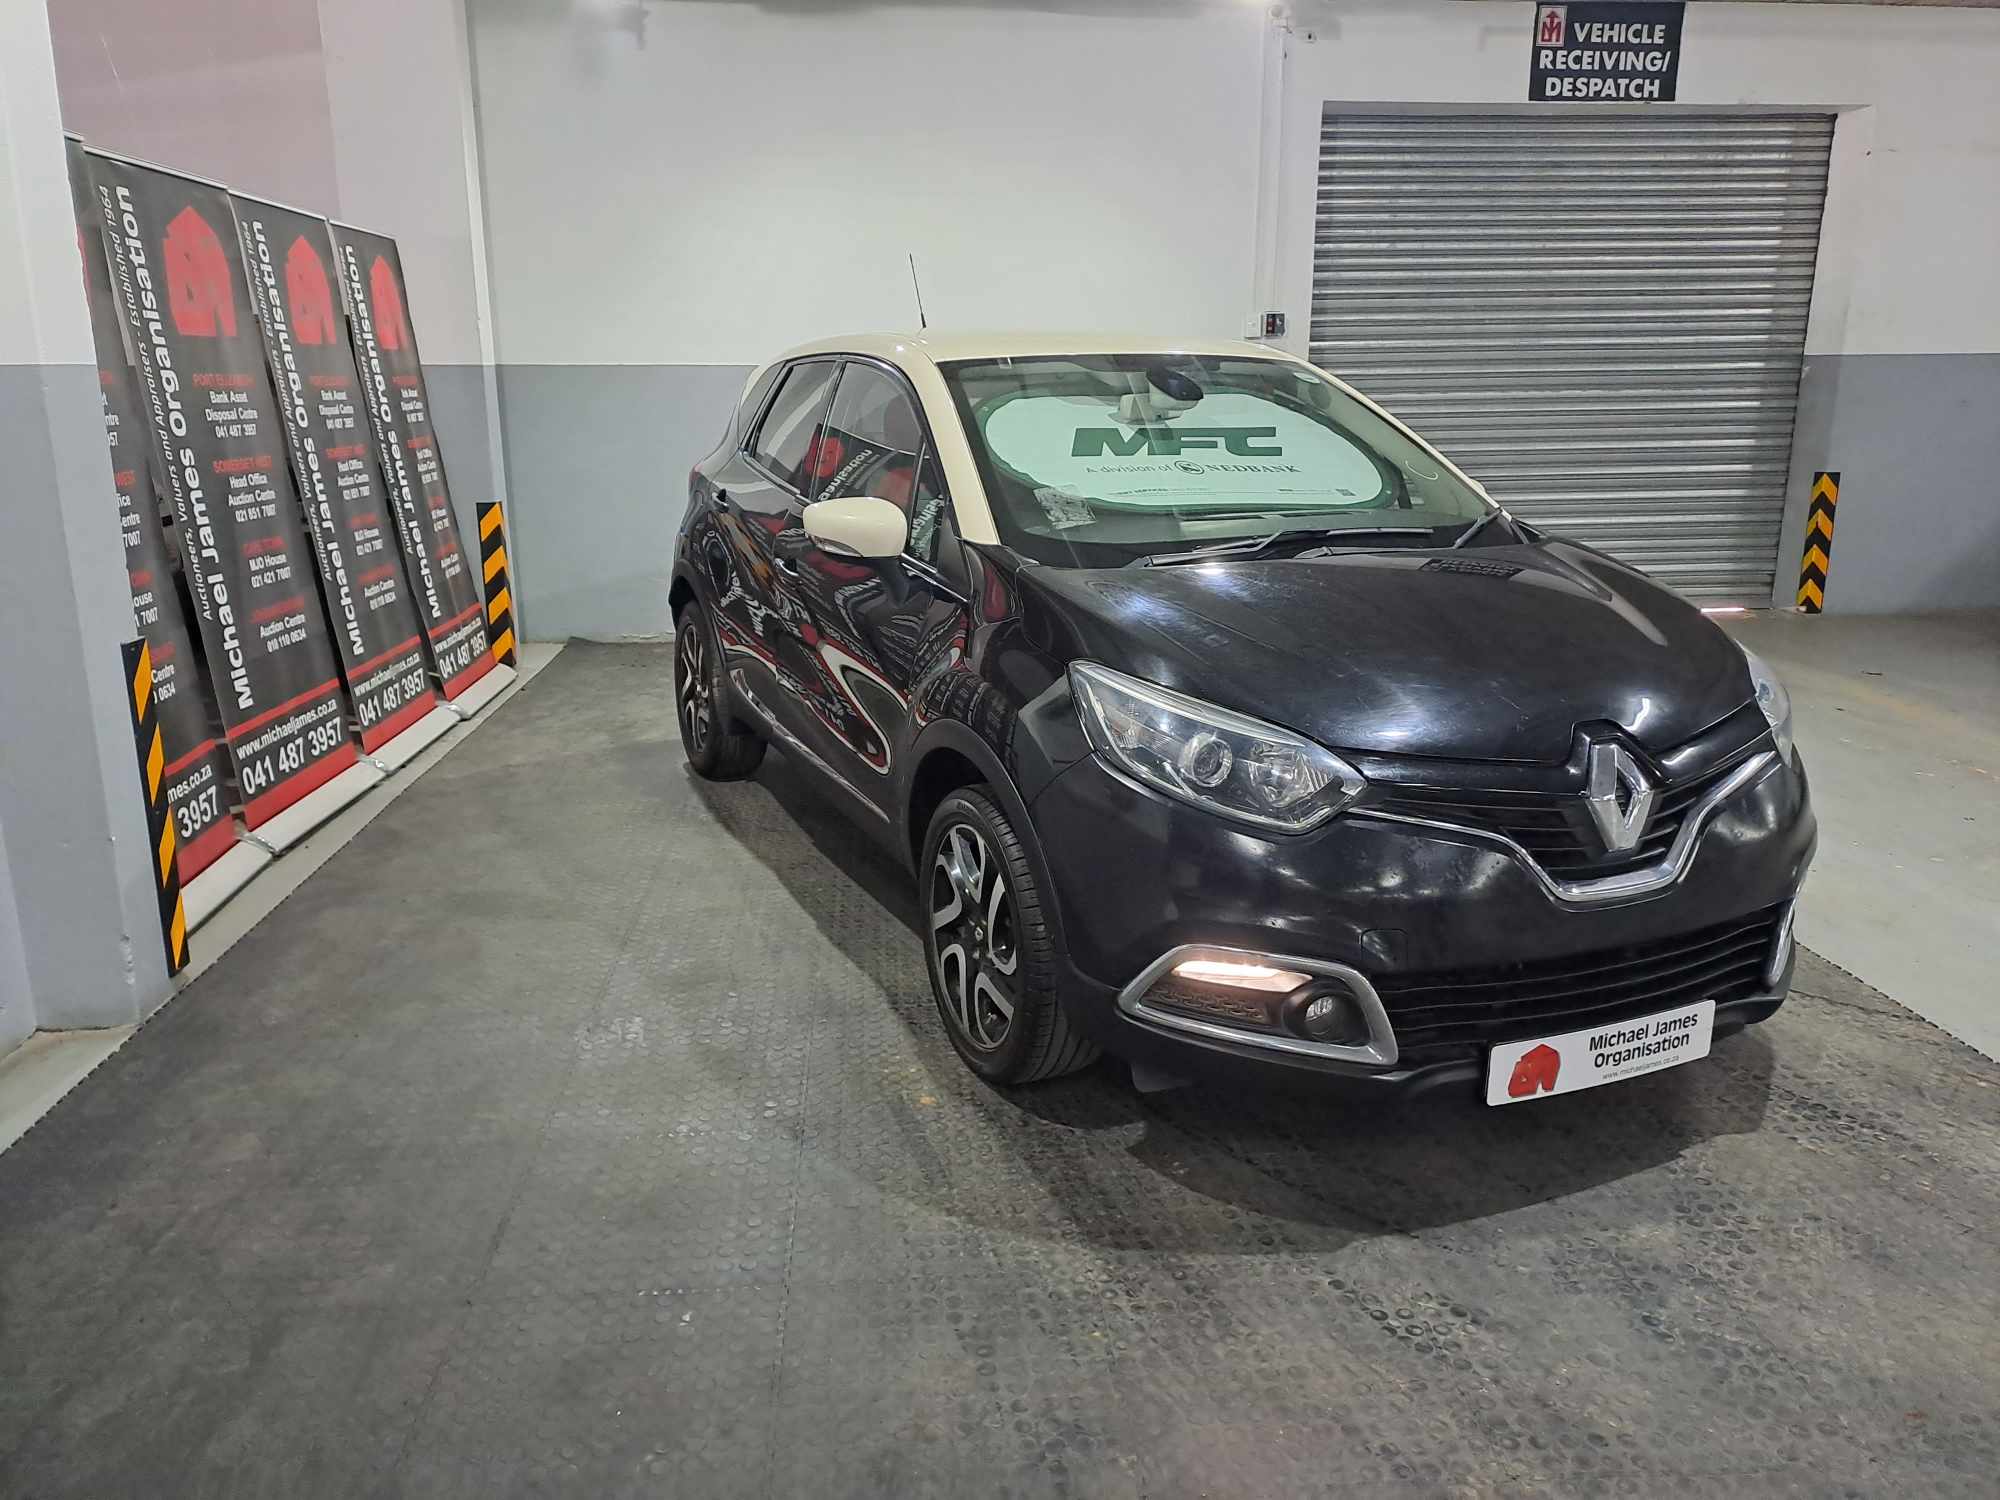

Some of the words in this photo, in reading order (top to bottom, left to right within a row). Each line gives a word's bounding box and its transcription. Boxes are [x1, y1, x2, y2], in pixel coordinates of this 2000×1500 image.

[1539, 50, 1671, 72] RECEIVING/
[1574, 23, 1666, 44] VEHICLE
[1545, 77, 1660, 98] DESPATCH
[99, 184, 117, 227] 1964
[109, 231, 140, 327] Established
[115, 185, 187, 437] Organisation
[252, 220, 309, 428] Organisation
[345, 244, 392, 423] Organisation
[138, 342, 166, 427] Appraisers
[158, 429, 173, 460] and
[387, 430, 415, 513] James
[1072, 427, 1282, 457] MFC
[1101, 463, 1157, 473] division
[1205, 464, 1302, 473] NEDBANK
[168, 465, 188, 522] Valuers
[180, 448, 220, 563] James
[304, 437, 335, 533] James
[326, 542, 364, 656] Michael
[408, 520, 441, 618] Michael
[207, 573, 254, 710] Michael
[439, 652, 458, 679] 041
[359, 695, 382, 726] 041
[383, 682, 401, 712] 487
[401, 667, 425, 699] 3957
[236, 698, 338, 760] www.michaeljames.co.za
[242, 755, 275, 795] 041
[278, 737, 305, 773] 487
[308, 716, 342, 756] 3957
[177, 784, 218, 838] 3957
[1589, 1024, 1650, 1052] Michael
[1652, 1013, 1698, 1038] James
[1594, 1032, 1690, 1070] Organisation
